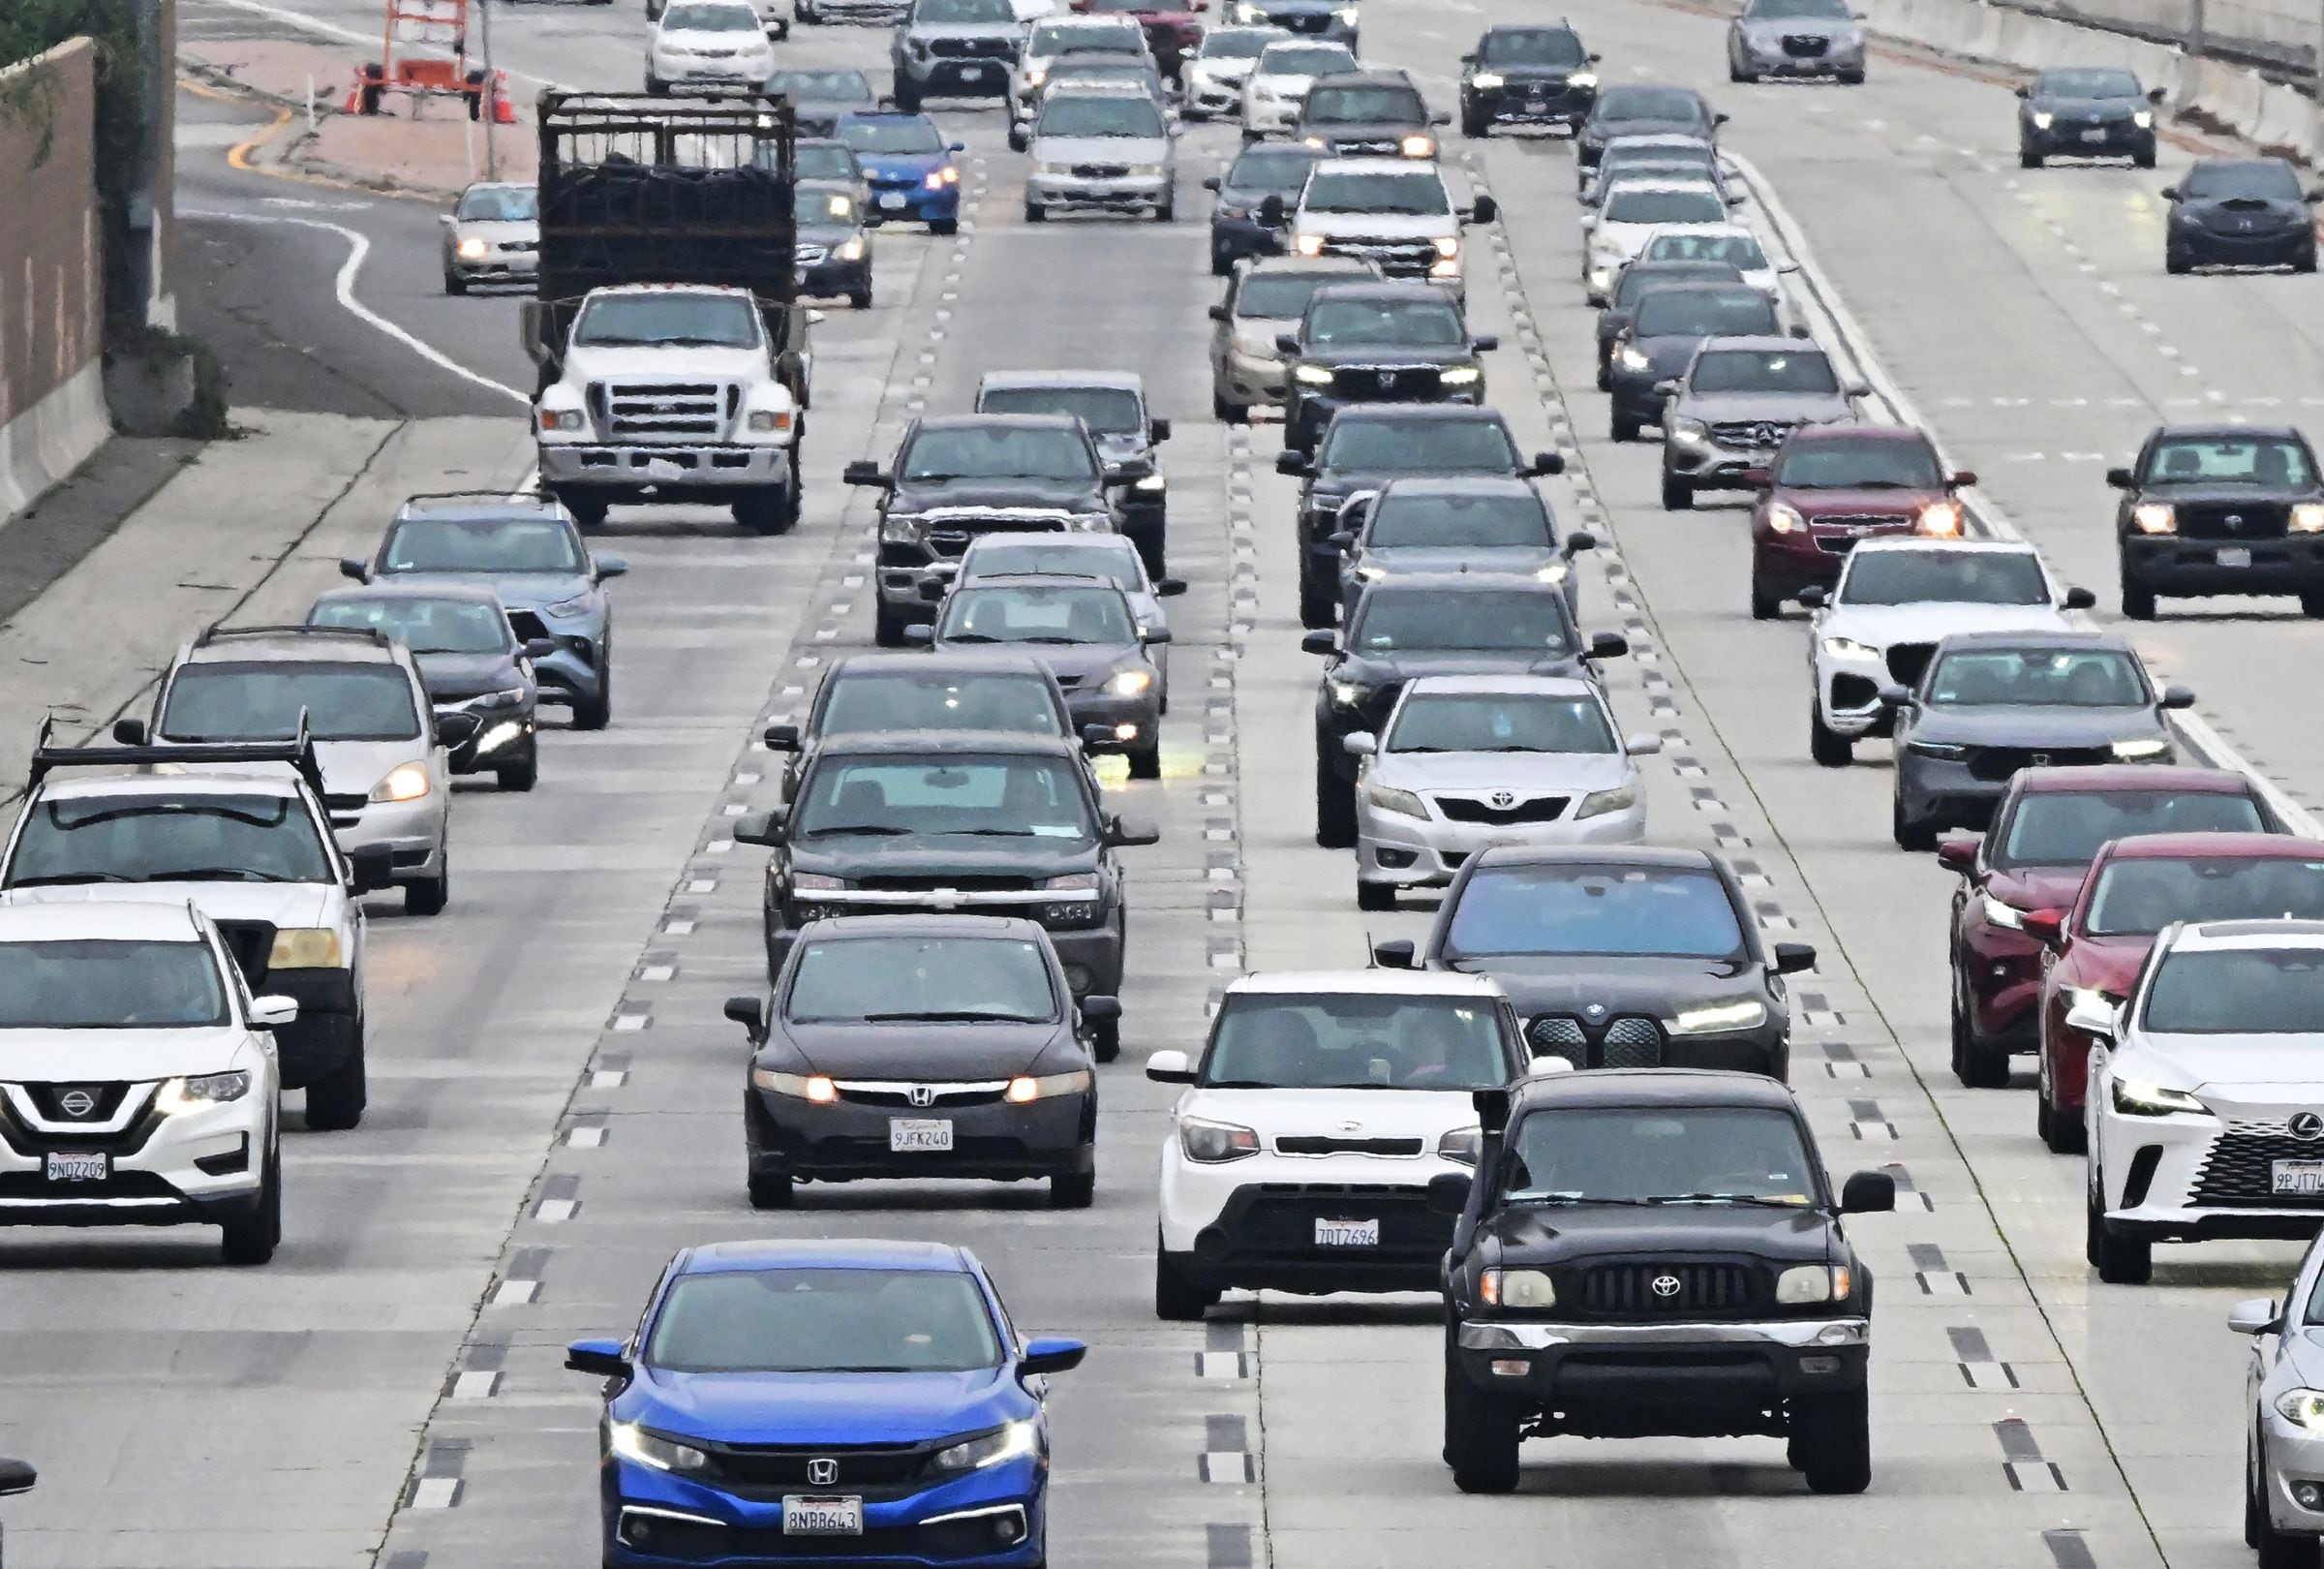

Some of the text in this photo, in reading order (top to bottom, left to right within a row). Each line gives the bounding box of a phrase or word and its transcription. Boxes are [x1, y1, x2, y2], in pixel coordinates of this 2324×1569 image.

[895, 1131, 948, 1146] 9JFK240
[2277, 1173, 2324, 1189] 9PJT74
[789, 1512, 856, 1528] 8NBB643
